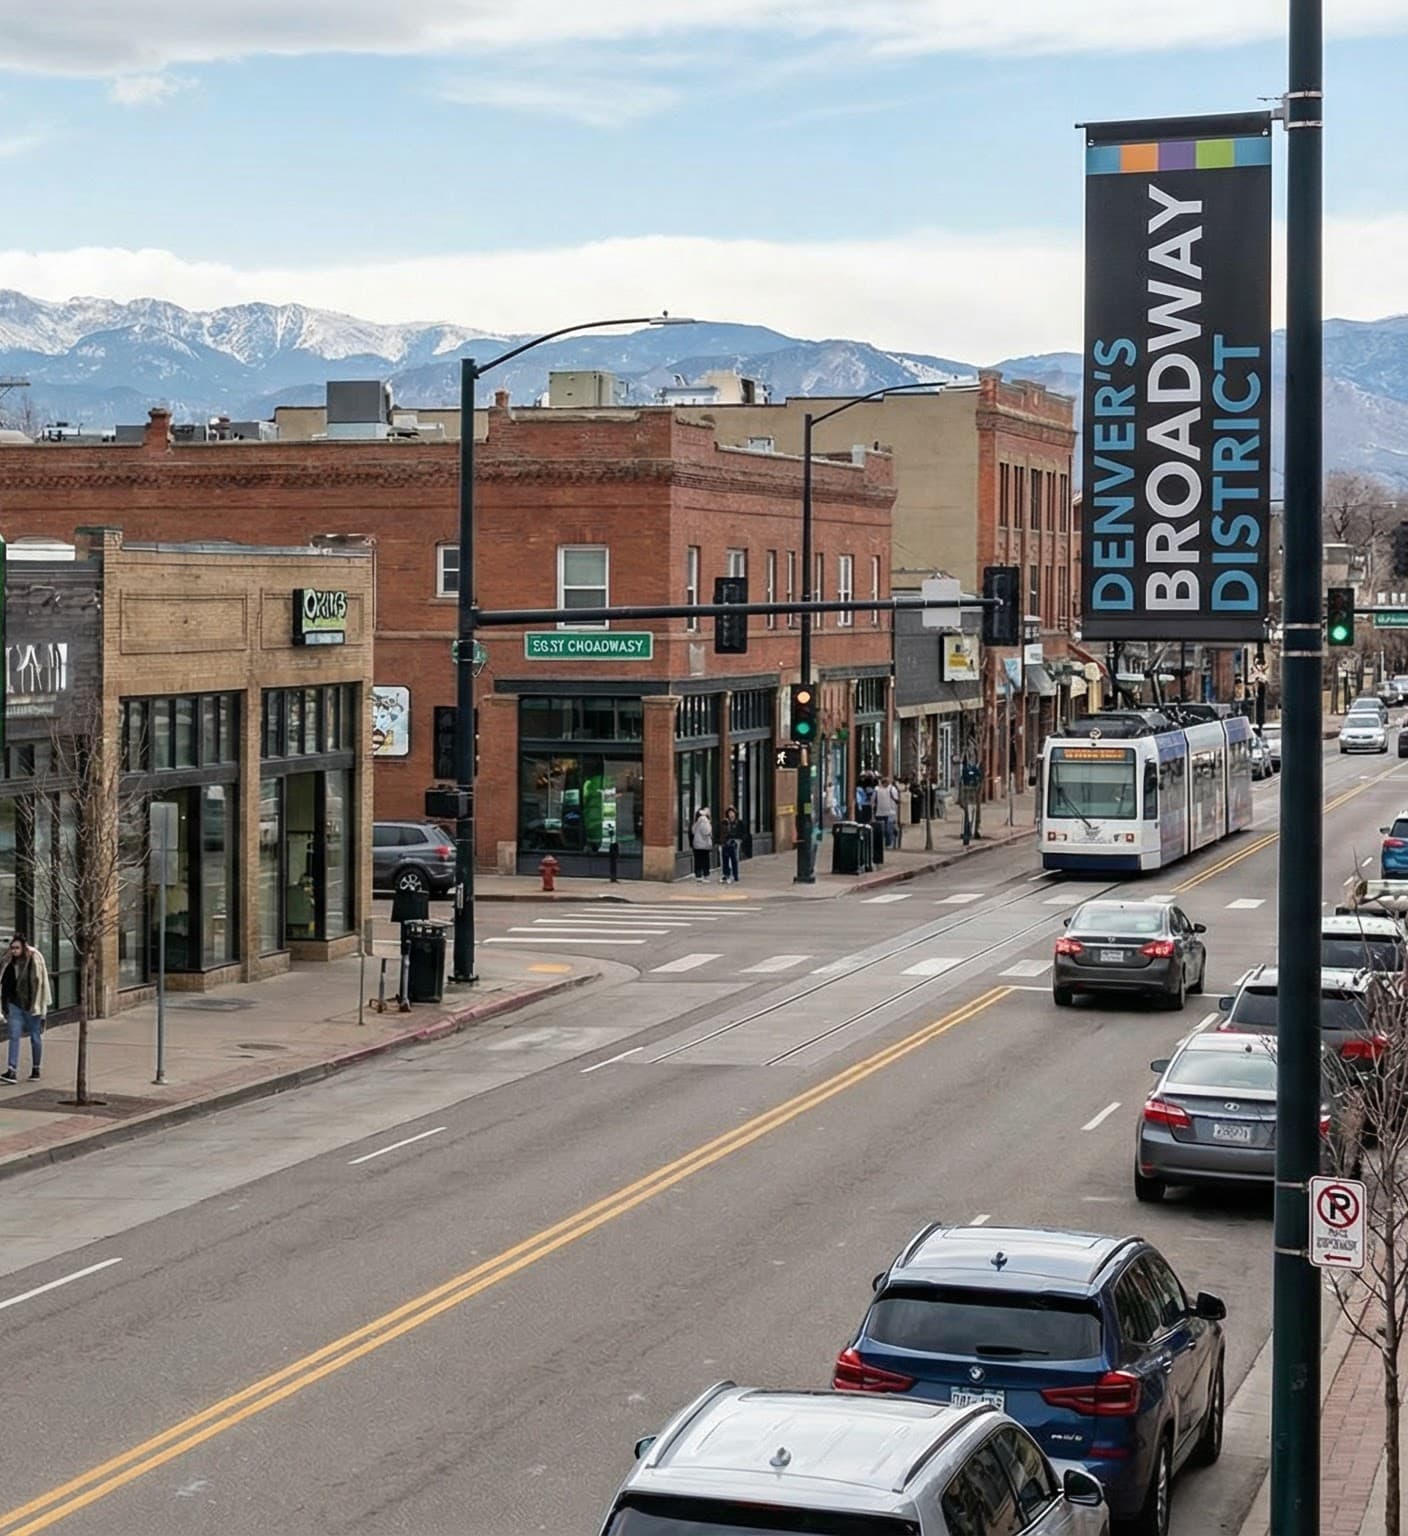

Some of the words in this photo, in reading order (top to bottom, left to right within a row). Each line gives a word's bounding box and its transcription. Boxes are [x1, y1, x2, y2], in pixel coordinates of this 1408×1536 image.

[1092, 336, 1137, 611] DENVER'S
[1145, 183, 1203, 611] BROADWAY
[1211, 334, 1261, 612] DISTRICT
